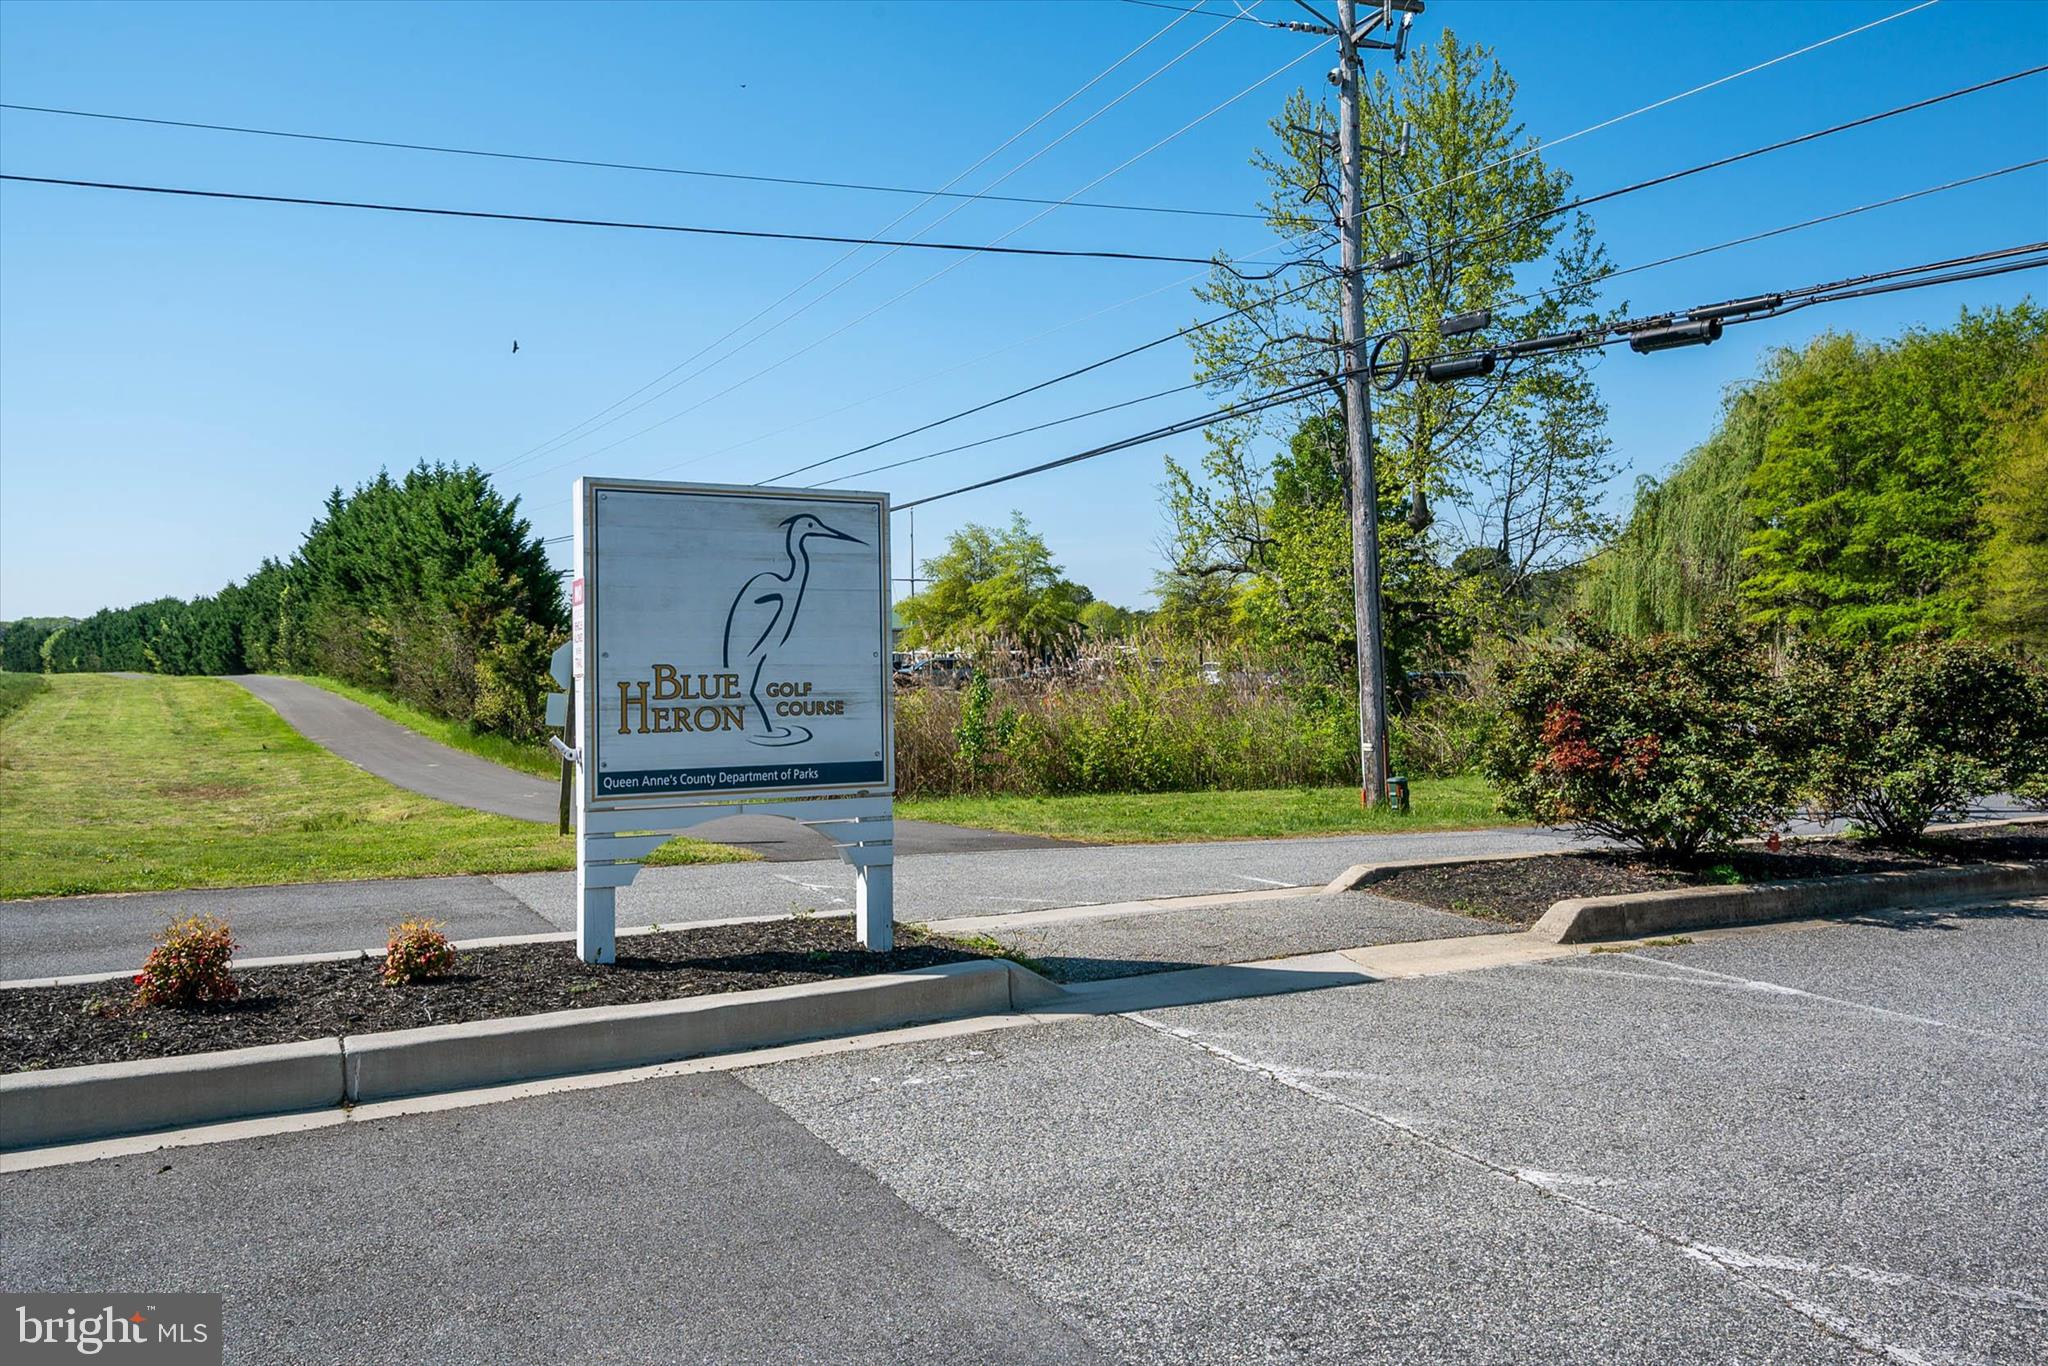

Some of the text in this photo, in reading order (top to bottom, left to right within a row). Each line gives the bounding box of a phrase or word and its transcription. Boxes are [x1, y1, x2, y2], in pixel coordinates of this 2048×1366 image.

[651, 664, 741, 700] BLUE
[766, 682, 812, 698] GOLF
[617, 681, 746, 734] HERON
[776, 700, 845, 717] COURSE
[603, 768, 819, 790] Queen Anne's County Department of Parks
